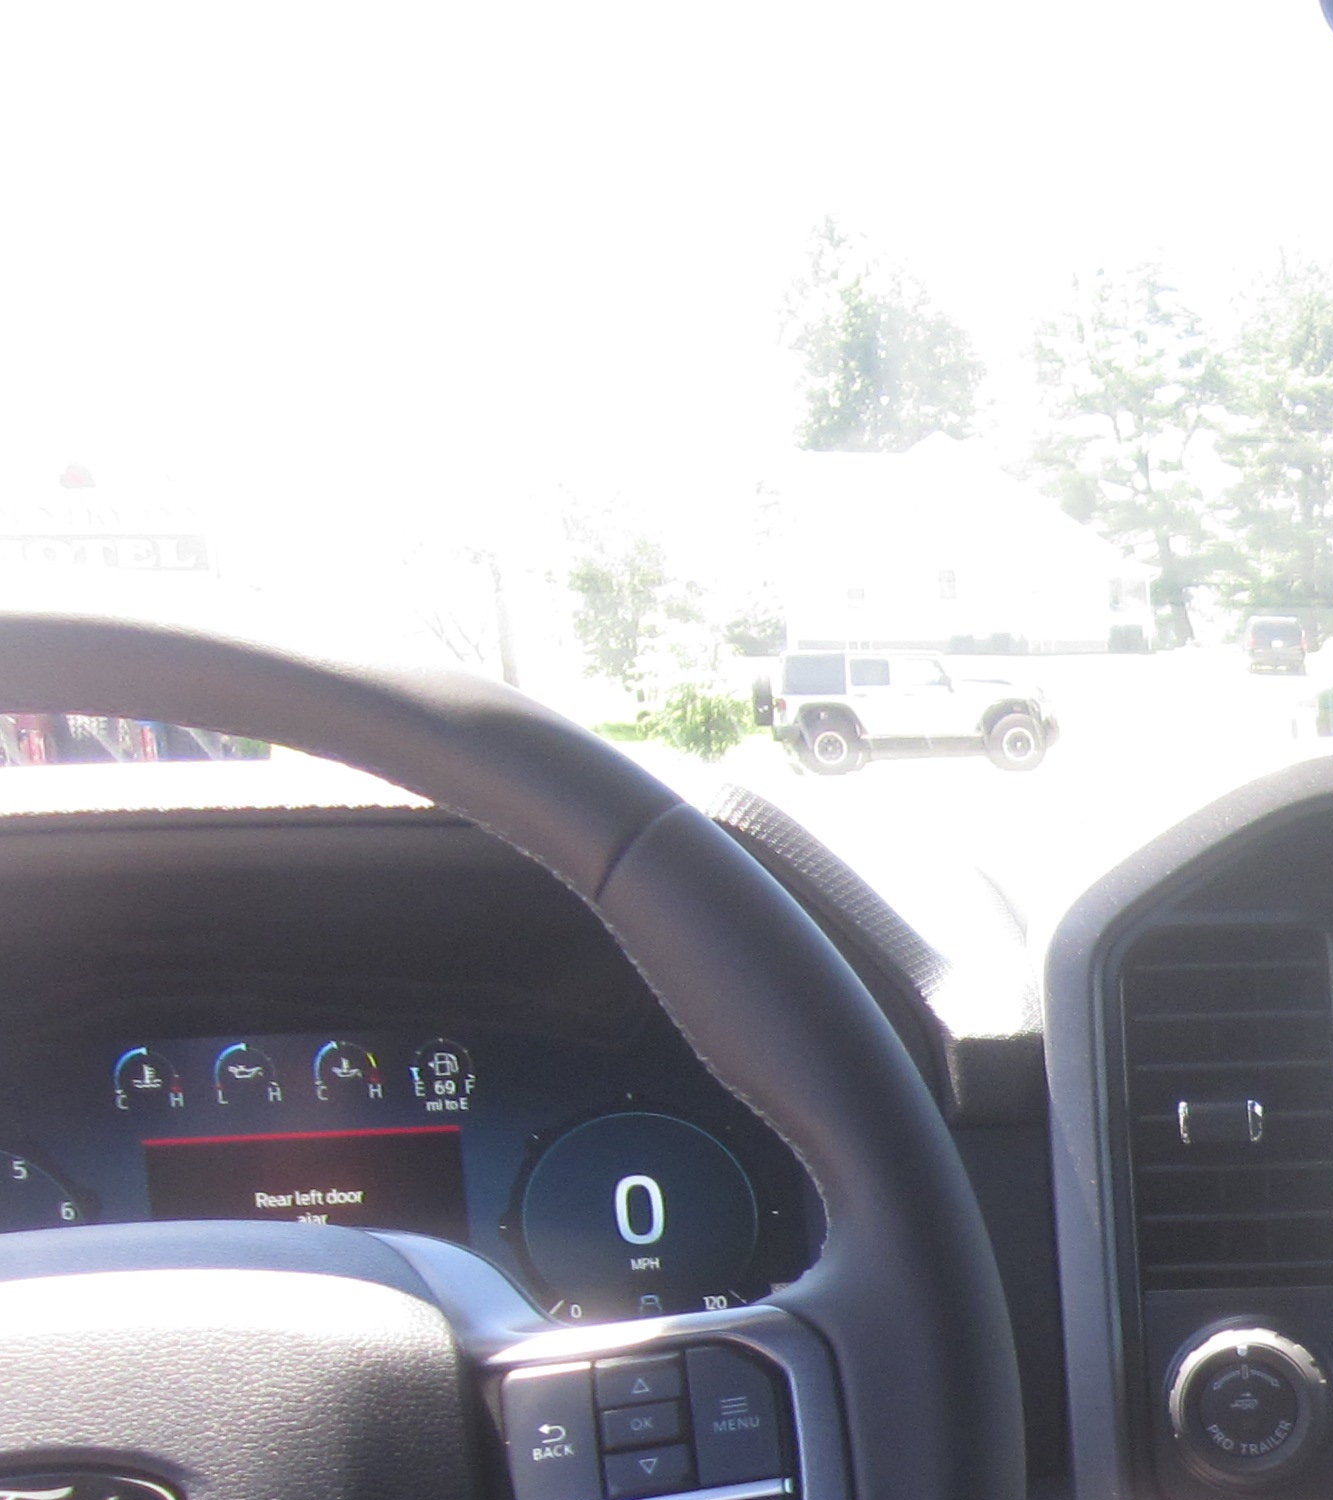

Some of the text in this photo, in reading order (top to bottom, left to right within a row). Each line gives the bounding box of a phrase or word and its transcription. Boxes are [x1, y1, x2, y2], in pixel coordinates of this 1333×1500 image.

[268, 1086, 282, 1102] H
[316, 1085, 328, 1100] C
[368, 1084, 382, 1099] H
[415, 1081, 426, 1097] E
[434, 1080, 456, 1095] 69
[465, 1079, 475, 1094] F
[116, 1095, 128, 1111] C
[170, 1092, 184, 1108] H
[217, 1089, 228, 1104] L
[426, 1097, 469, 1112] mi to E
[13, 1160, 28, 1179] 5
[254, 1188, 364, 1208] Rear left door
[60, 1203, 75, 1221] 6
[614, 1174, 665, 1245] 0
[630, 1257, 660, 1271] MPH
[570, 1304, 582, 1319] 0
[630, 1417, 653, 1431] OK
[713, 1416, 760, 1433] MENU
[1207, 1420, 1292, 1455] PRO TRAILER
[532, 1443, 574, 1462] BACK
